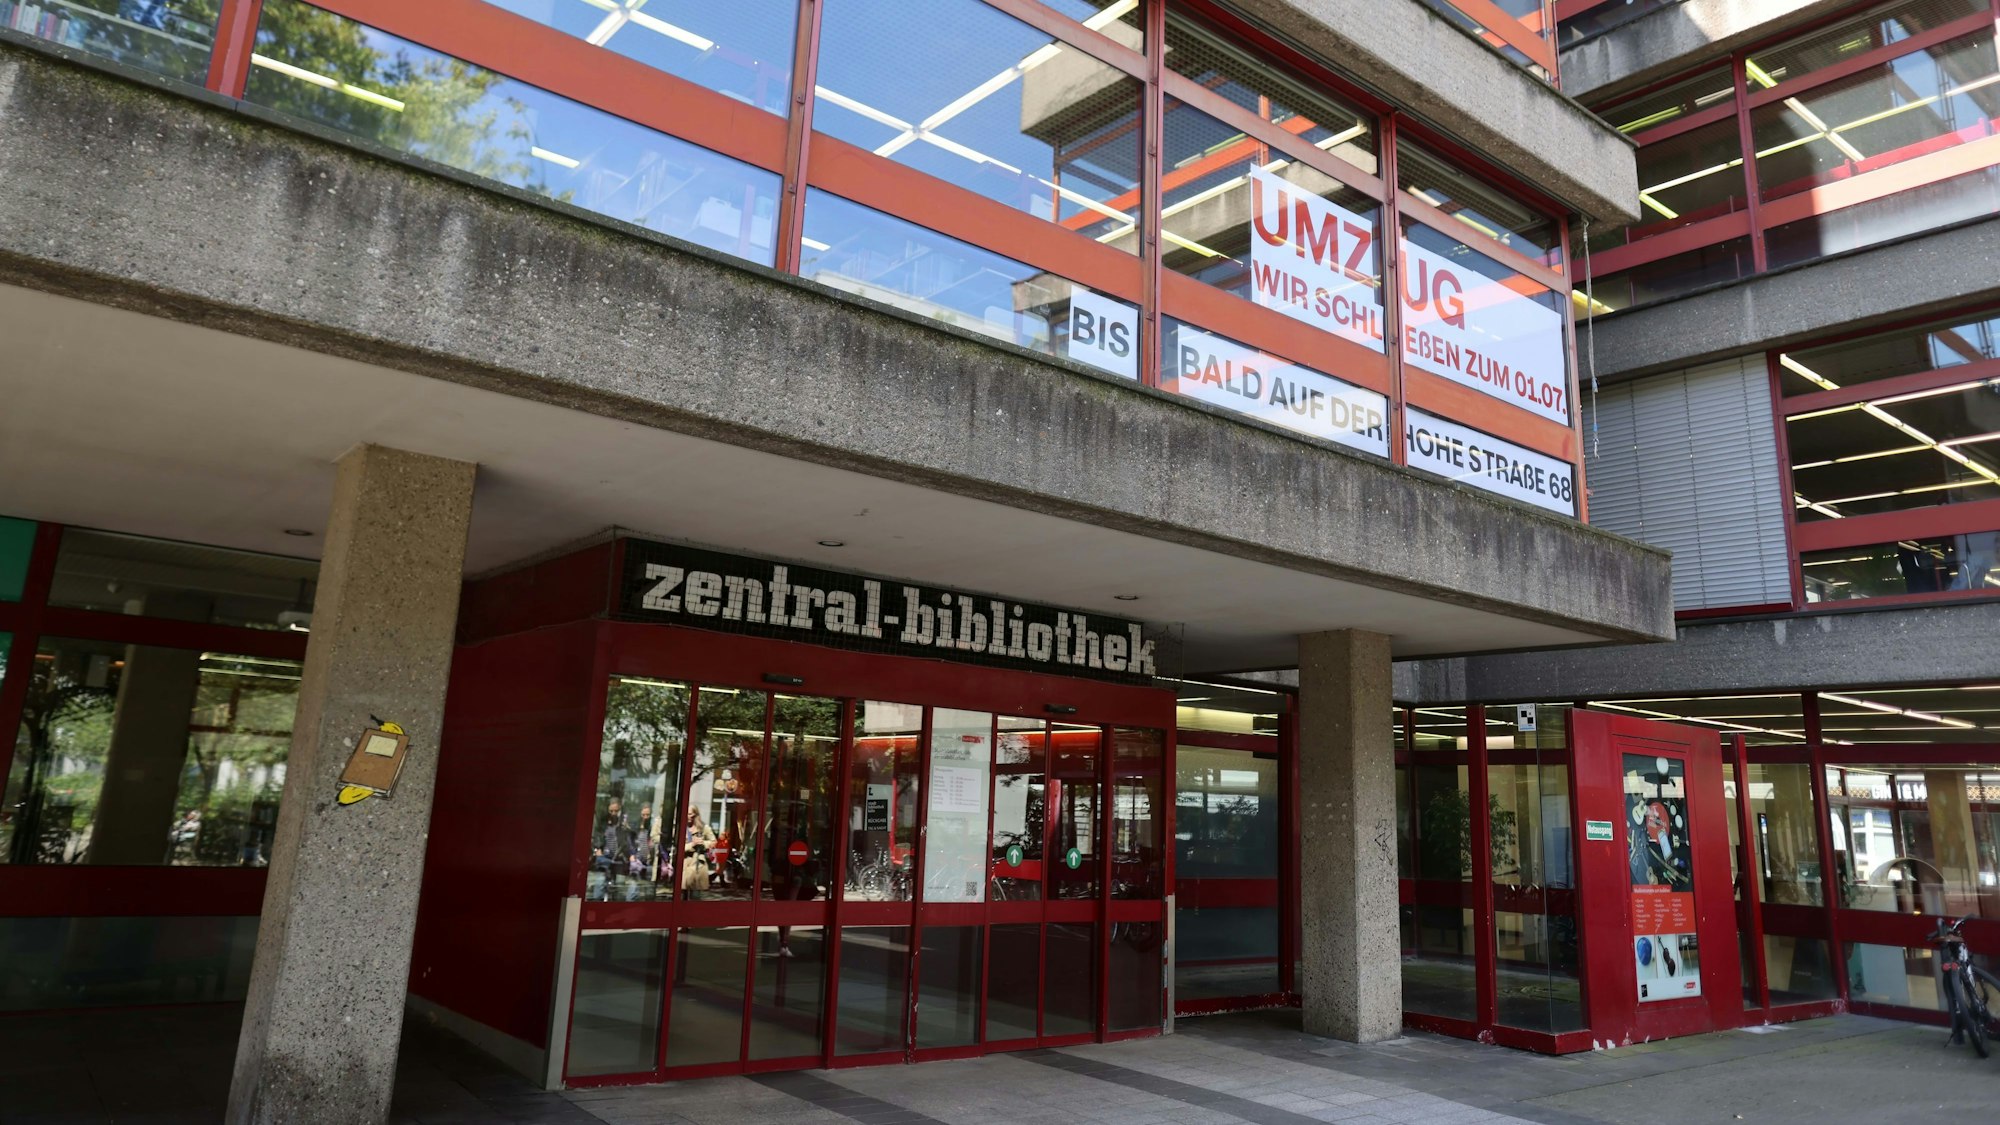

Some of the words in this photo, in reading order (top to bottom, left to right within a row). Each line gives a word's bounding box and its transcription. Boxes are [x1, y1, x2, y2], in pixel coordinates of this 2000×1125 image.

[1072, 305, 1130, 358] BIS
[1181, 344, 1262, 400] BALD
[1269, 376, 1324, 419] AUF
[1331, 396, 1383, 441] DER
[1468, 445, 1545, 494] STRAßE
[1549, 473, 1571, 502] 68
[1253, 259, 1308, 310] WIR
[1315, 287, 1460, 371] SCHLEßEN
[1465, 348, 1510, 391] ZUM
[1514, 371, 1568, 415] 01.07.
[642, 562, 1156, 676] zentral-bibliothek
